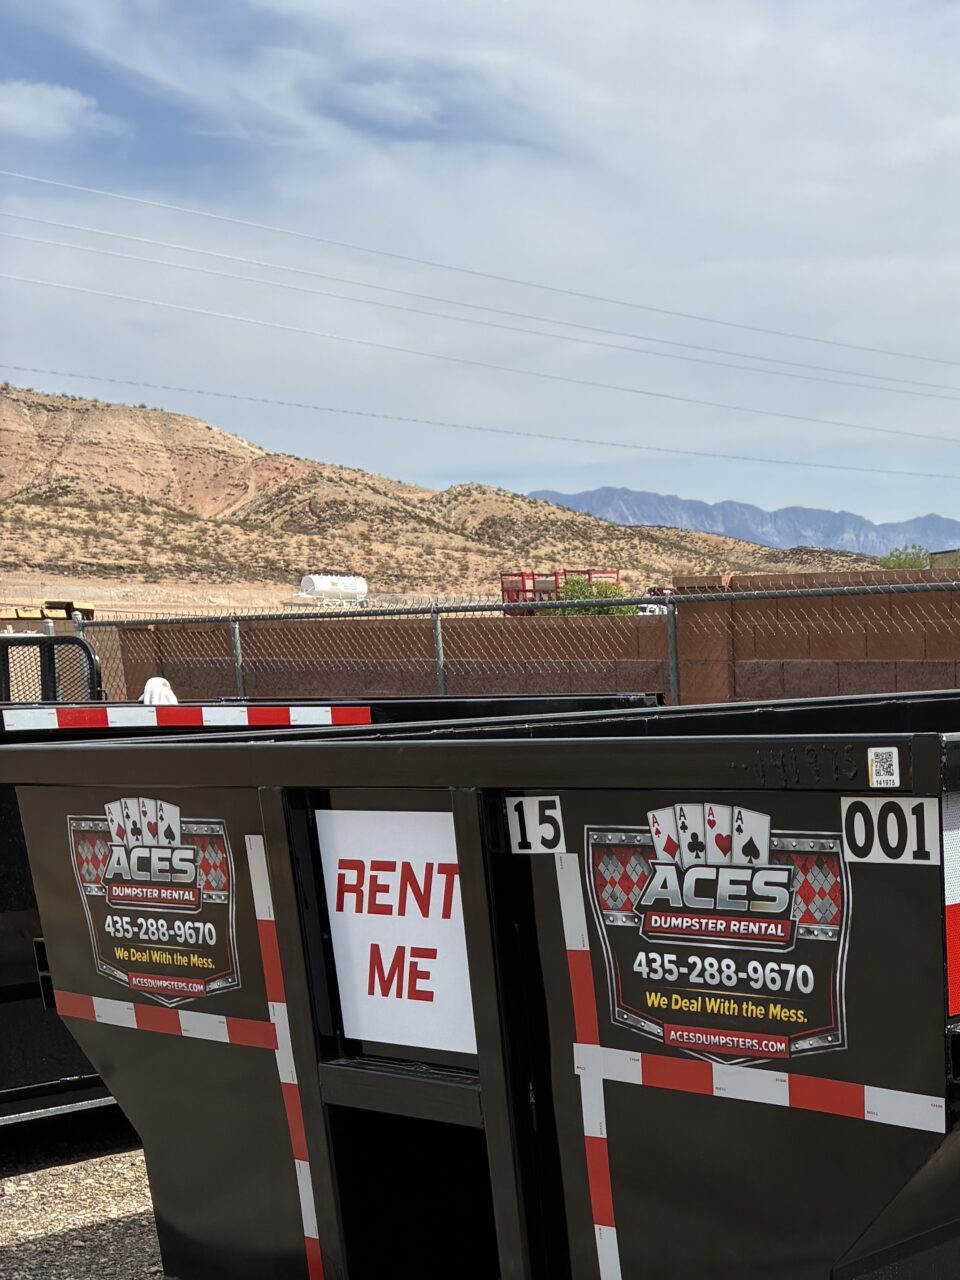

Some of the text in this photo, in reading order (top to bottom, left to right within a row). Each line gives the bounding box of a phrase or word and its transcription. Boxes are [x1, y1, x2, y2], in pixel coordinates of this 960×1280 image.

[124, 800, 129, 811] A
[142, 800, 147, 811] A
[159, 802, 164, 814] A
[679, 807, 687, 821] A
[707, 806, 715, 819] A
[514, 800, 561, 850] 15
[652, 813, 660, 827] A
[736, 810, 744, 825] A
[845, 801, 930, 861] 001
[105, 846, 196, 882] ACES
[112, 886, 195, 901] DUMPSTER RENTAL
[335, 858, 460, 919] RENT
[641, 865, 790, 913] ACES
[105, 915, 217, 945] 435-288-9670
[651, 915, 785, 937] DUMPSTER RENTAL
[114, 947, 215, 969] We Deal With the Mess.
[368, 943, 437, 1002] ME
[632, 951, 815, 994] 435-288-9670
[132, 978, 204, 992] ACESDUMPSTERS.COM
[646, 991, 808, 1023] We Deal With the Mess.
[669, 1030, 786, 1053] ACESDUMPSTERS.COM
